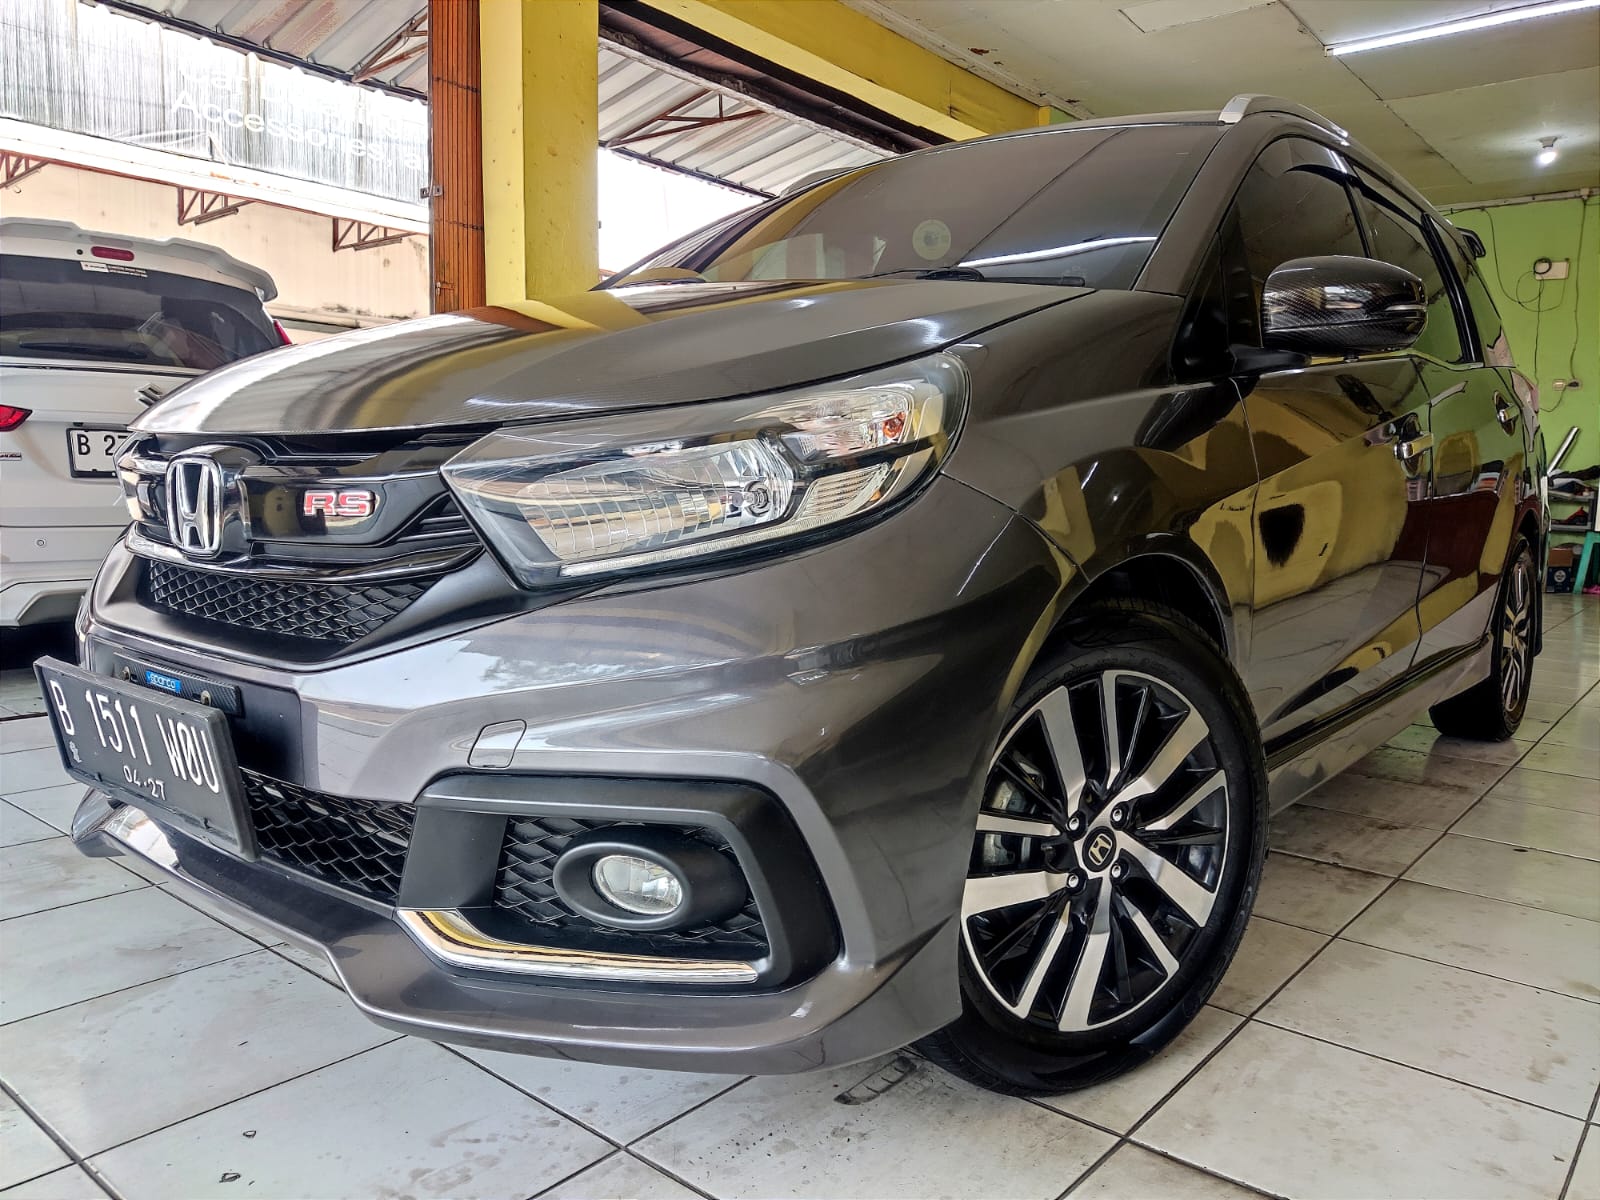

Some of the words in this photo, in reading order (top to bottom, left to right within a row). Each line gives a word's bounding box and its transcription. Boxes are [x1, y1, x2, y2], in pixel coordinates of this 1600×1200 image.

[77, 433, 91, 456] B
[303, 489, 371, 517] RS
[50, 679, 75, 734] B
[85, 689, 153, 767] 1511
